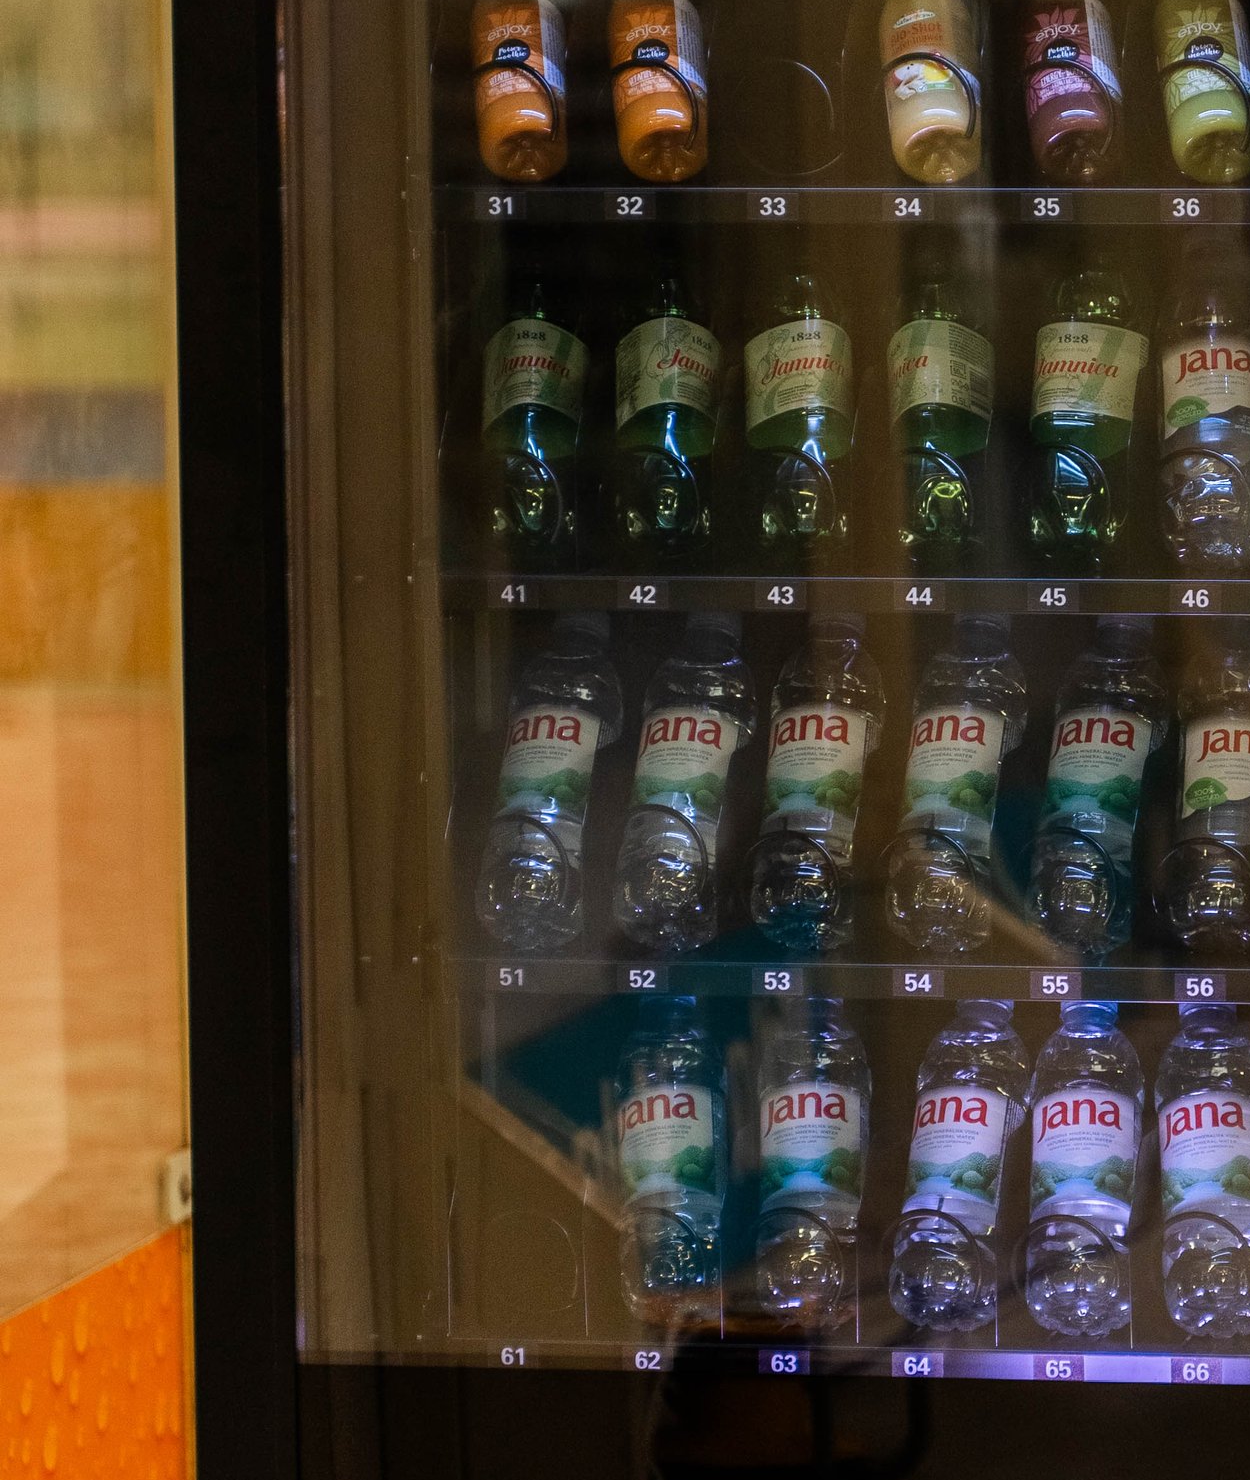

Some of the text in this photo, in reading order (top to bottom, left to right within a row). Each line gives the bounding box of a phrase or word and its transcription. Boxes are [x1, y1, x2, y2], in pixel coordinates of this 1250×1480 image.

[489, 196, 512, 215] 31
[617, 196, 643, 215] 32
[760, 197, 786, 216] 33
[895, 198, 921, 216] 34
[1034, 198, 1060, 216] 35
[1173, 198, 1200, 217] 36
[516, 330, 547, 342] 1828
[790, 331, 821, 343] 1828
[1058, 333, 1089, 344] 1828
[501, 585, 525, 602] 41
[630, 586, 656, 604] 42
[767, 586, 794, 604] 43
[906, 587, 932, 605] 44
[1040, 588, 1066, 606] 45
[1182, 589, 1209, 608] 46
[769, 713, 850, 760] jana
[1052, 717, 1135, 760] jana
[500, 968, 523, 986] 51
[629, 970, 655, 988] 52
[765, 972, 790, 990] 53
[905, 973, 931, 992] 54
[1043, 976, 1069, 994] 55
[1187, 978, 1213, 996] 56
[764, 1091, 848, 1138] jana
[1037, 1099, 1123, 1143] jana
[1163, 1101, 1247, 1151] jana
[501, 1346, 525, 1365] 61
[635, 1350, 661, 1369] 62
[771, 1354, 797, 1372] 63
[904, 1357, 931, 1376] 64
[1046, 1360, 1071, 1379] 65
[1183, 1362, 1209, 1381] 66
